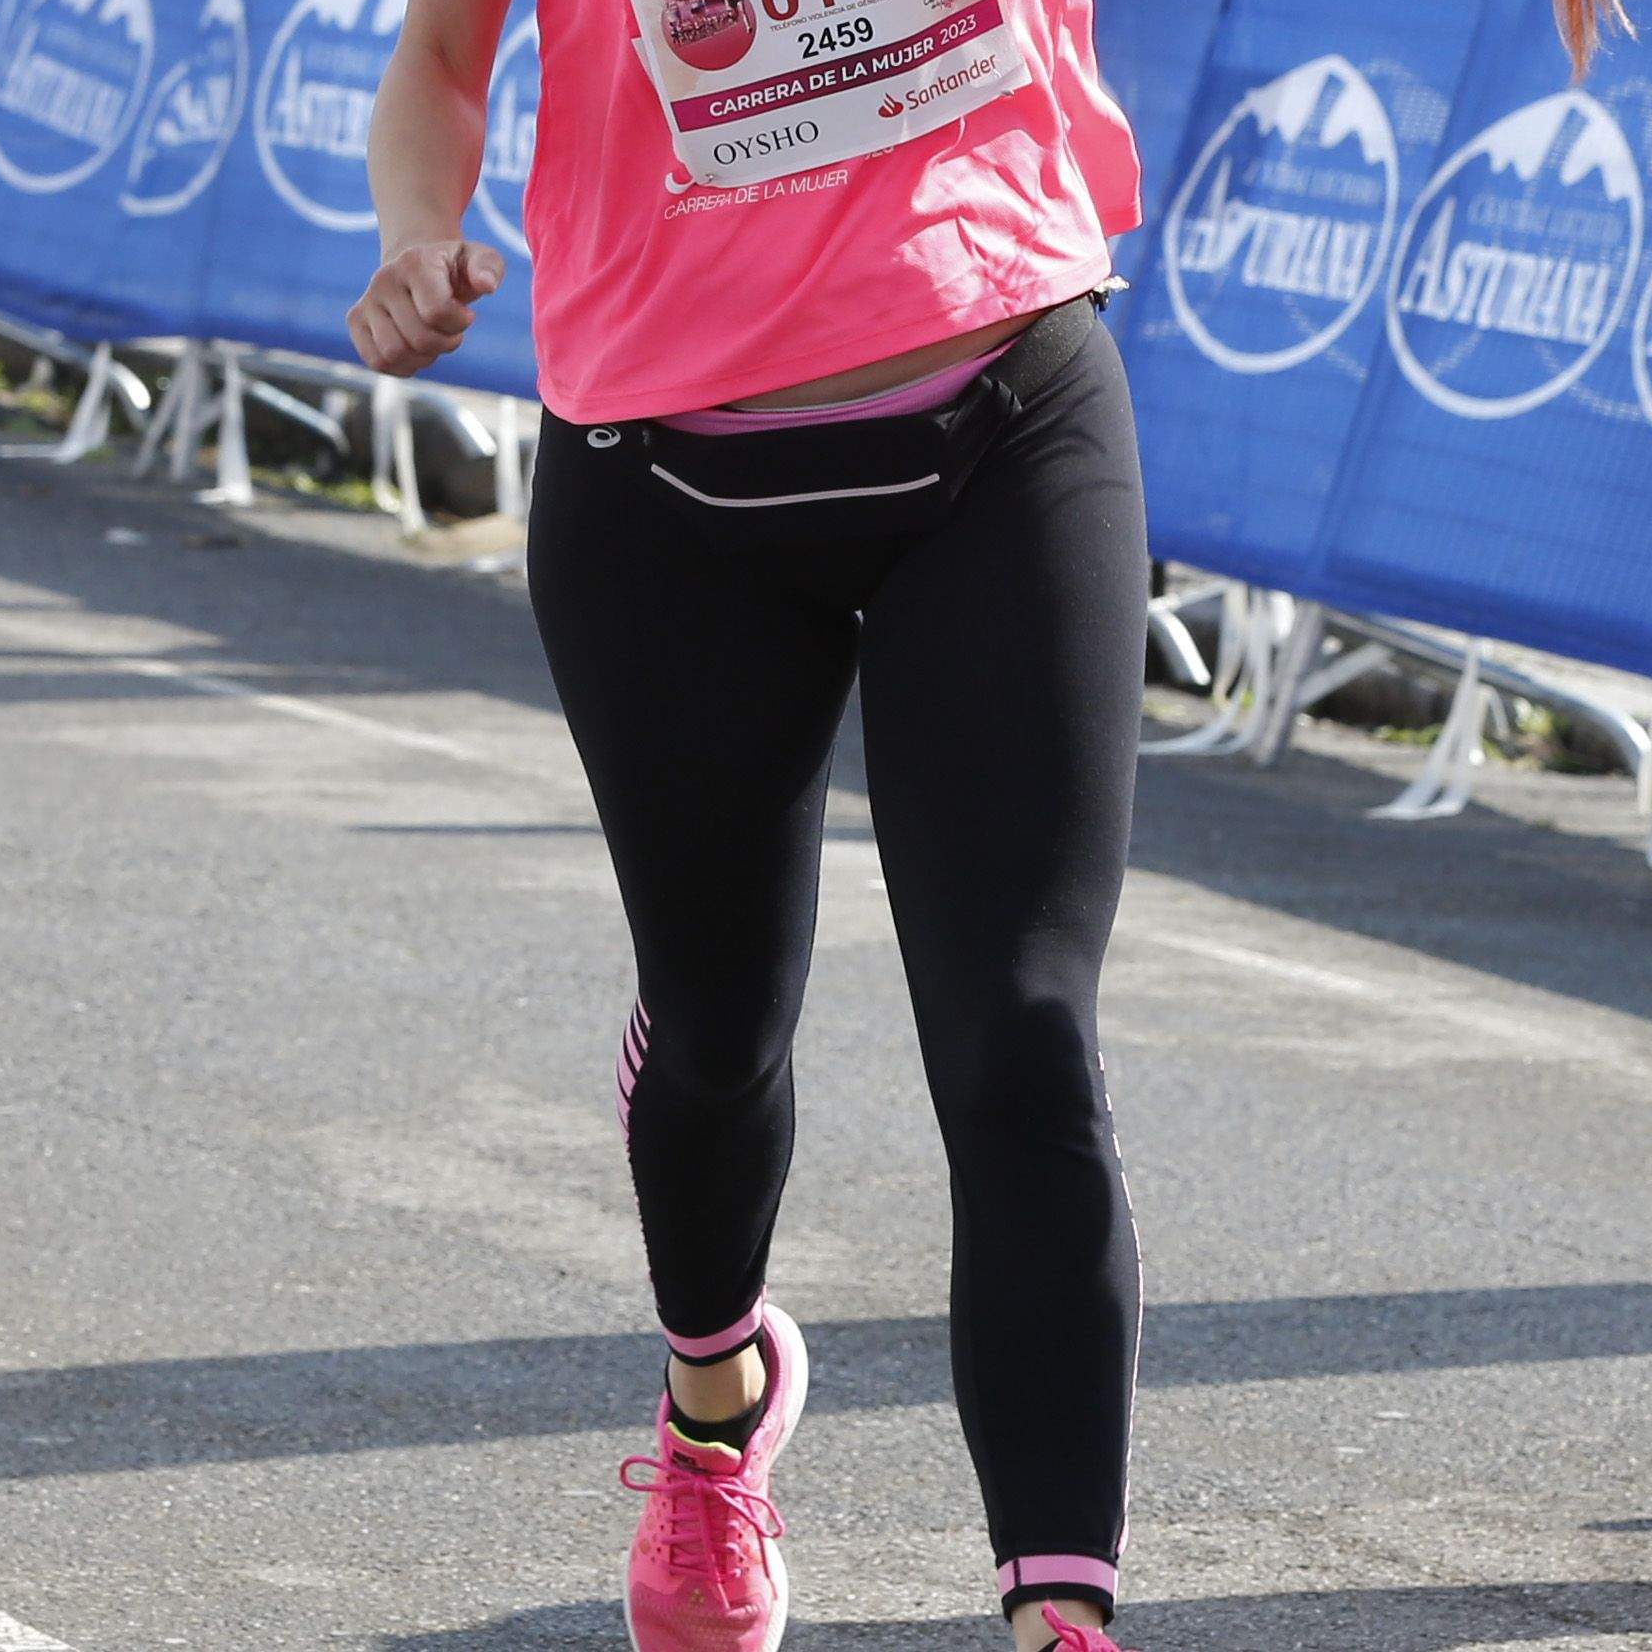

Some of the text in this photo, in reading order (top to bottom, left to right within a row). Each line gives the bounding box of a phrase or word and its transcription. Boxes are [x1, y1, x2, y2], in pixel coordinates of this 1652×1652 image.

[808, 7, 846, 23] VIOLENCIA
[846, 3, 857, 12] DE
[797, 16, 874, 60] 2459
[709, 14, 979, 118] CARRERA DE LA MUJER 2023
[905, 52, 999, 111] Santander
[713, 120, 820, 166] OYSHO
[664, 169, 849, 221] CARRERA DE LA MUJER
